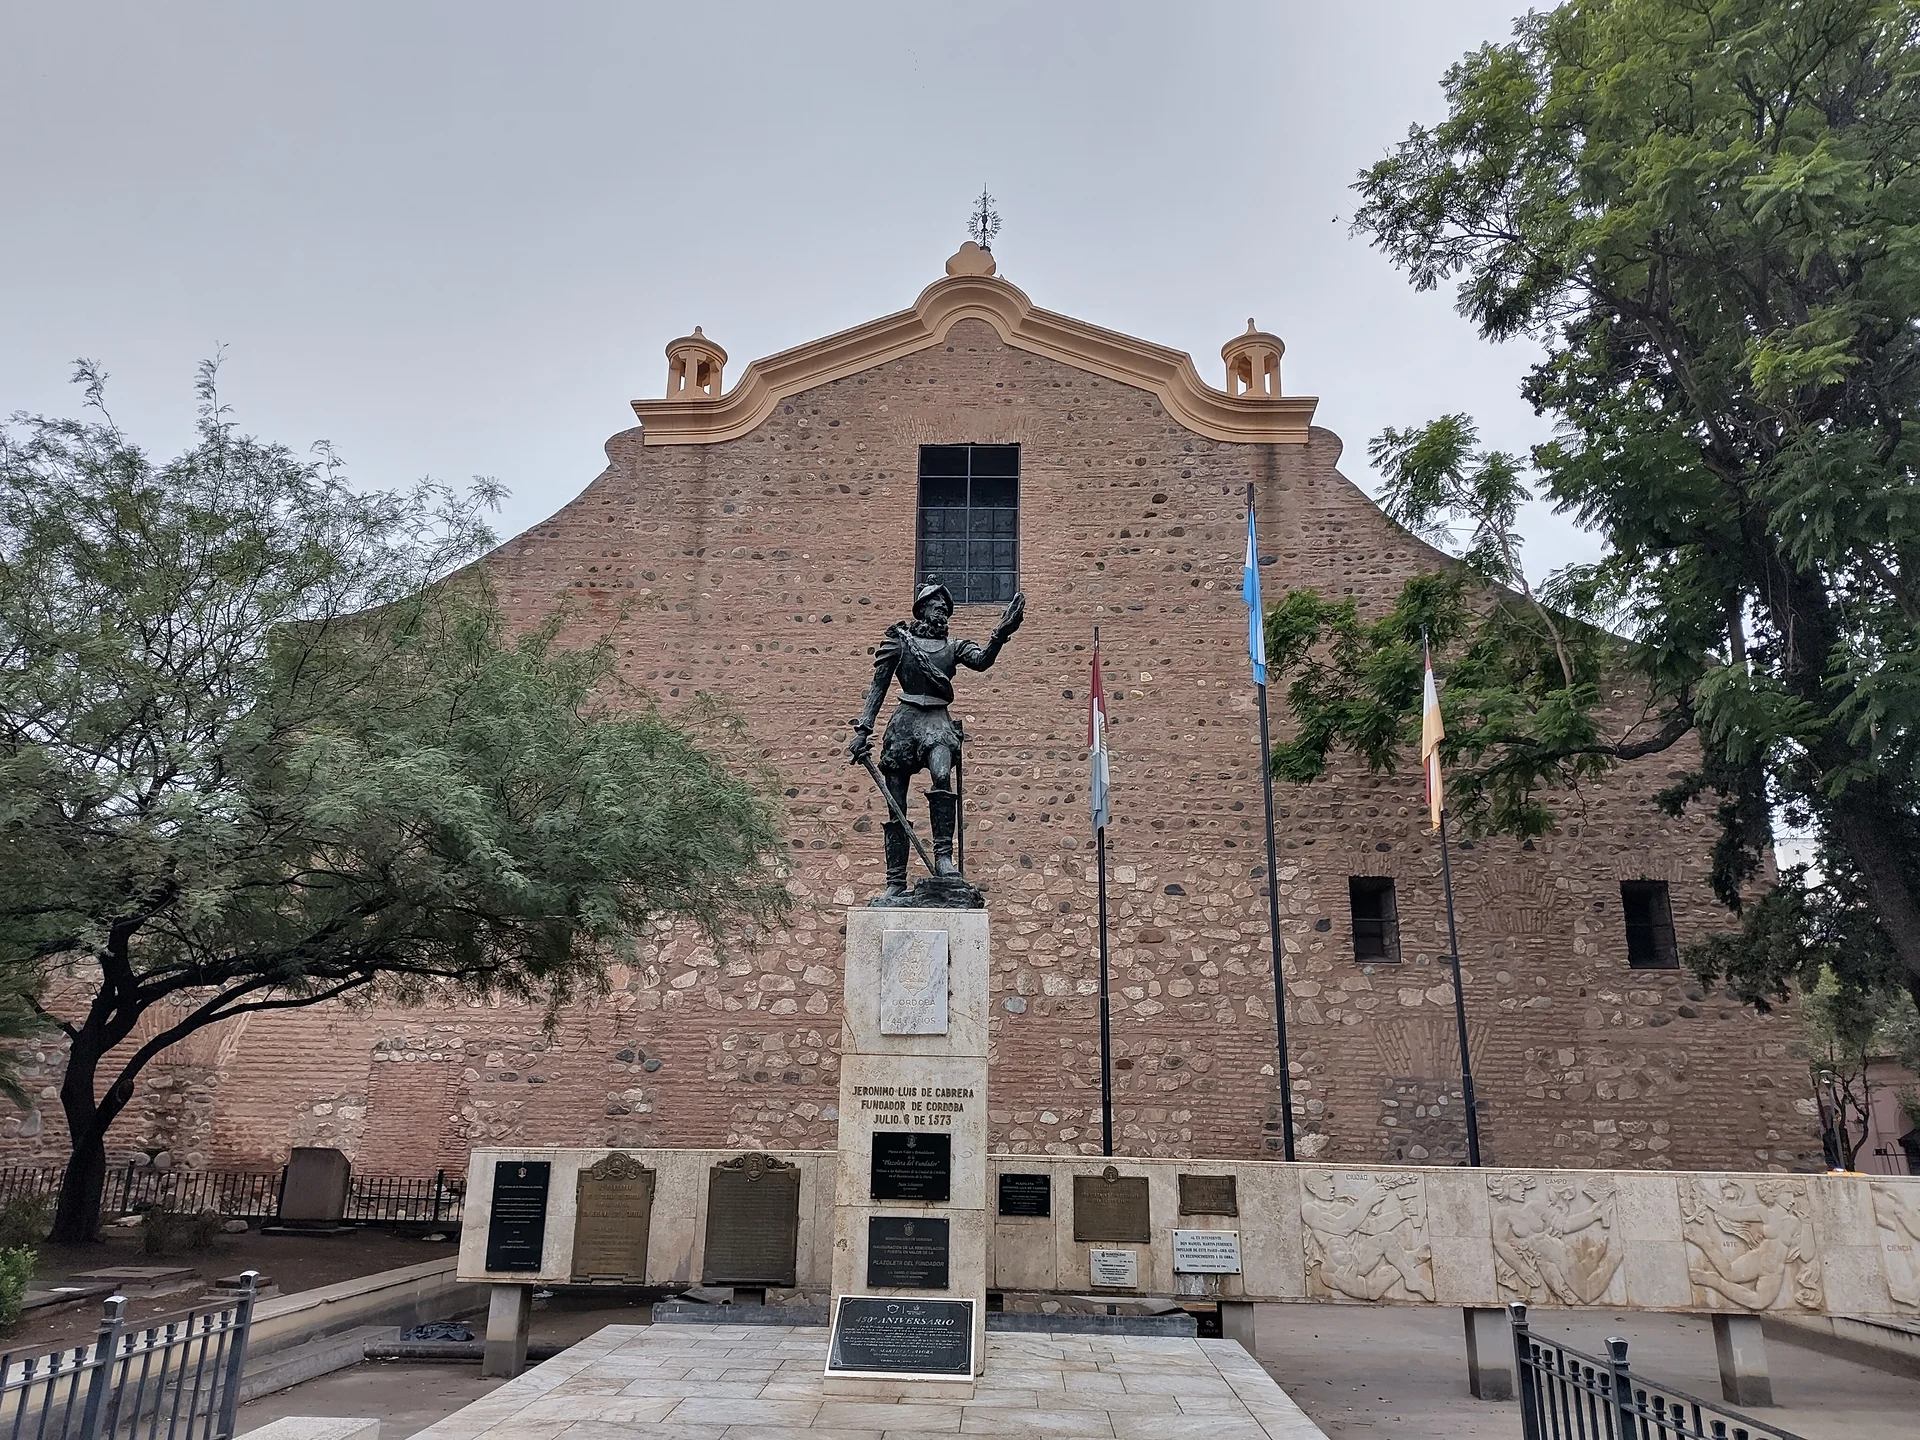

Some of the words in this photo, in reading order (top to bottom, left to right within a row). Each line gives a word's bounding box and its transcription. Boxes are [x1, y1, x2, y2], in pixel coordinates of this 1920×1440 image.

[852, 1086, 894, 1096] JERONIMO
[898, 1087, 917, 1097] LUIS
[921, 1088, 932, 1097] DE
[935, 1088, 974, 1098] CABRERA
[861, 1100, 906, 1110] FUNDADOR
[912, 1102, 922, 1111] DE
[926, 1102, 964, 1112] CORDOBA
[903, 1114, 910, 1125] 6
[914, 1116, 925, 1125] DE
[928, 1115, 952, 1125] 1573
[877, 1317, 954, 1326] ANIVERSARIO
